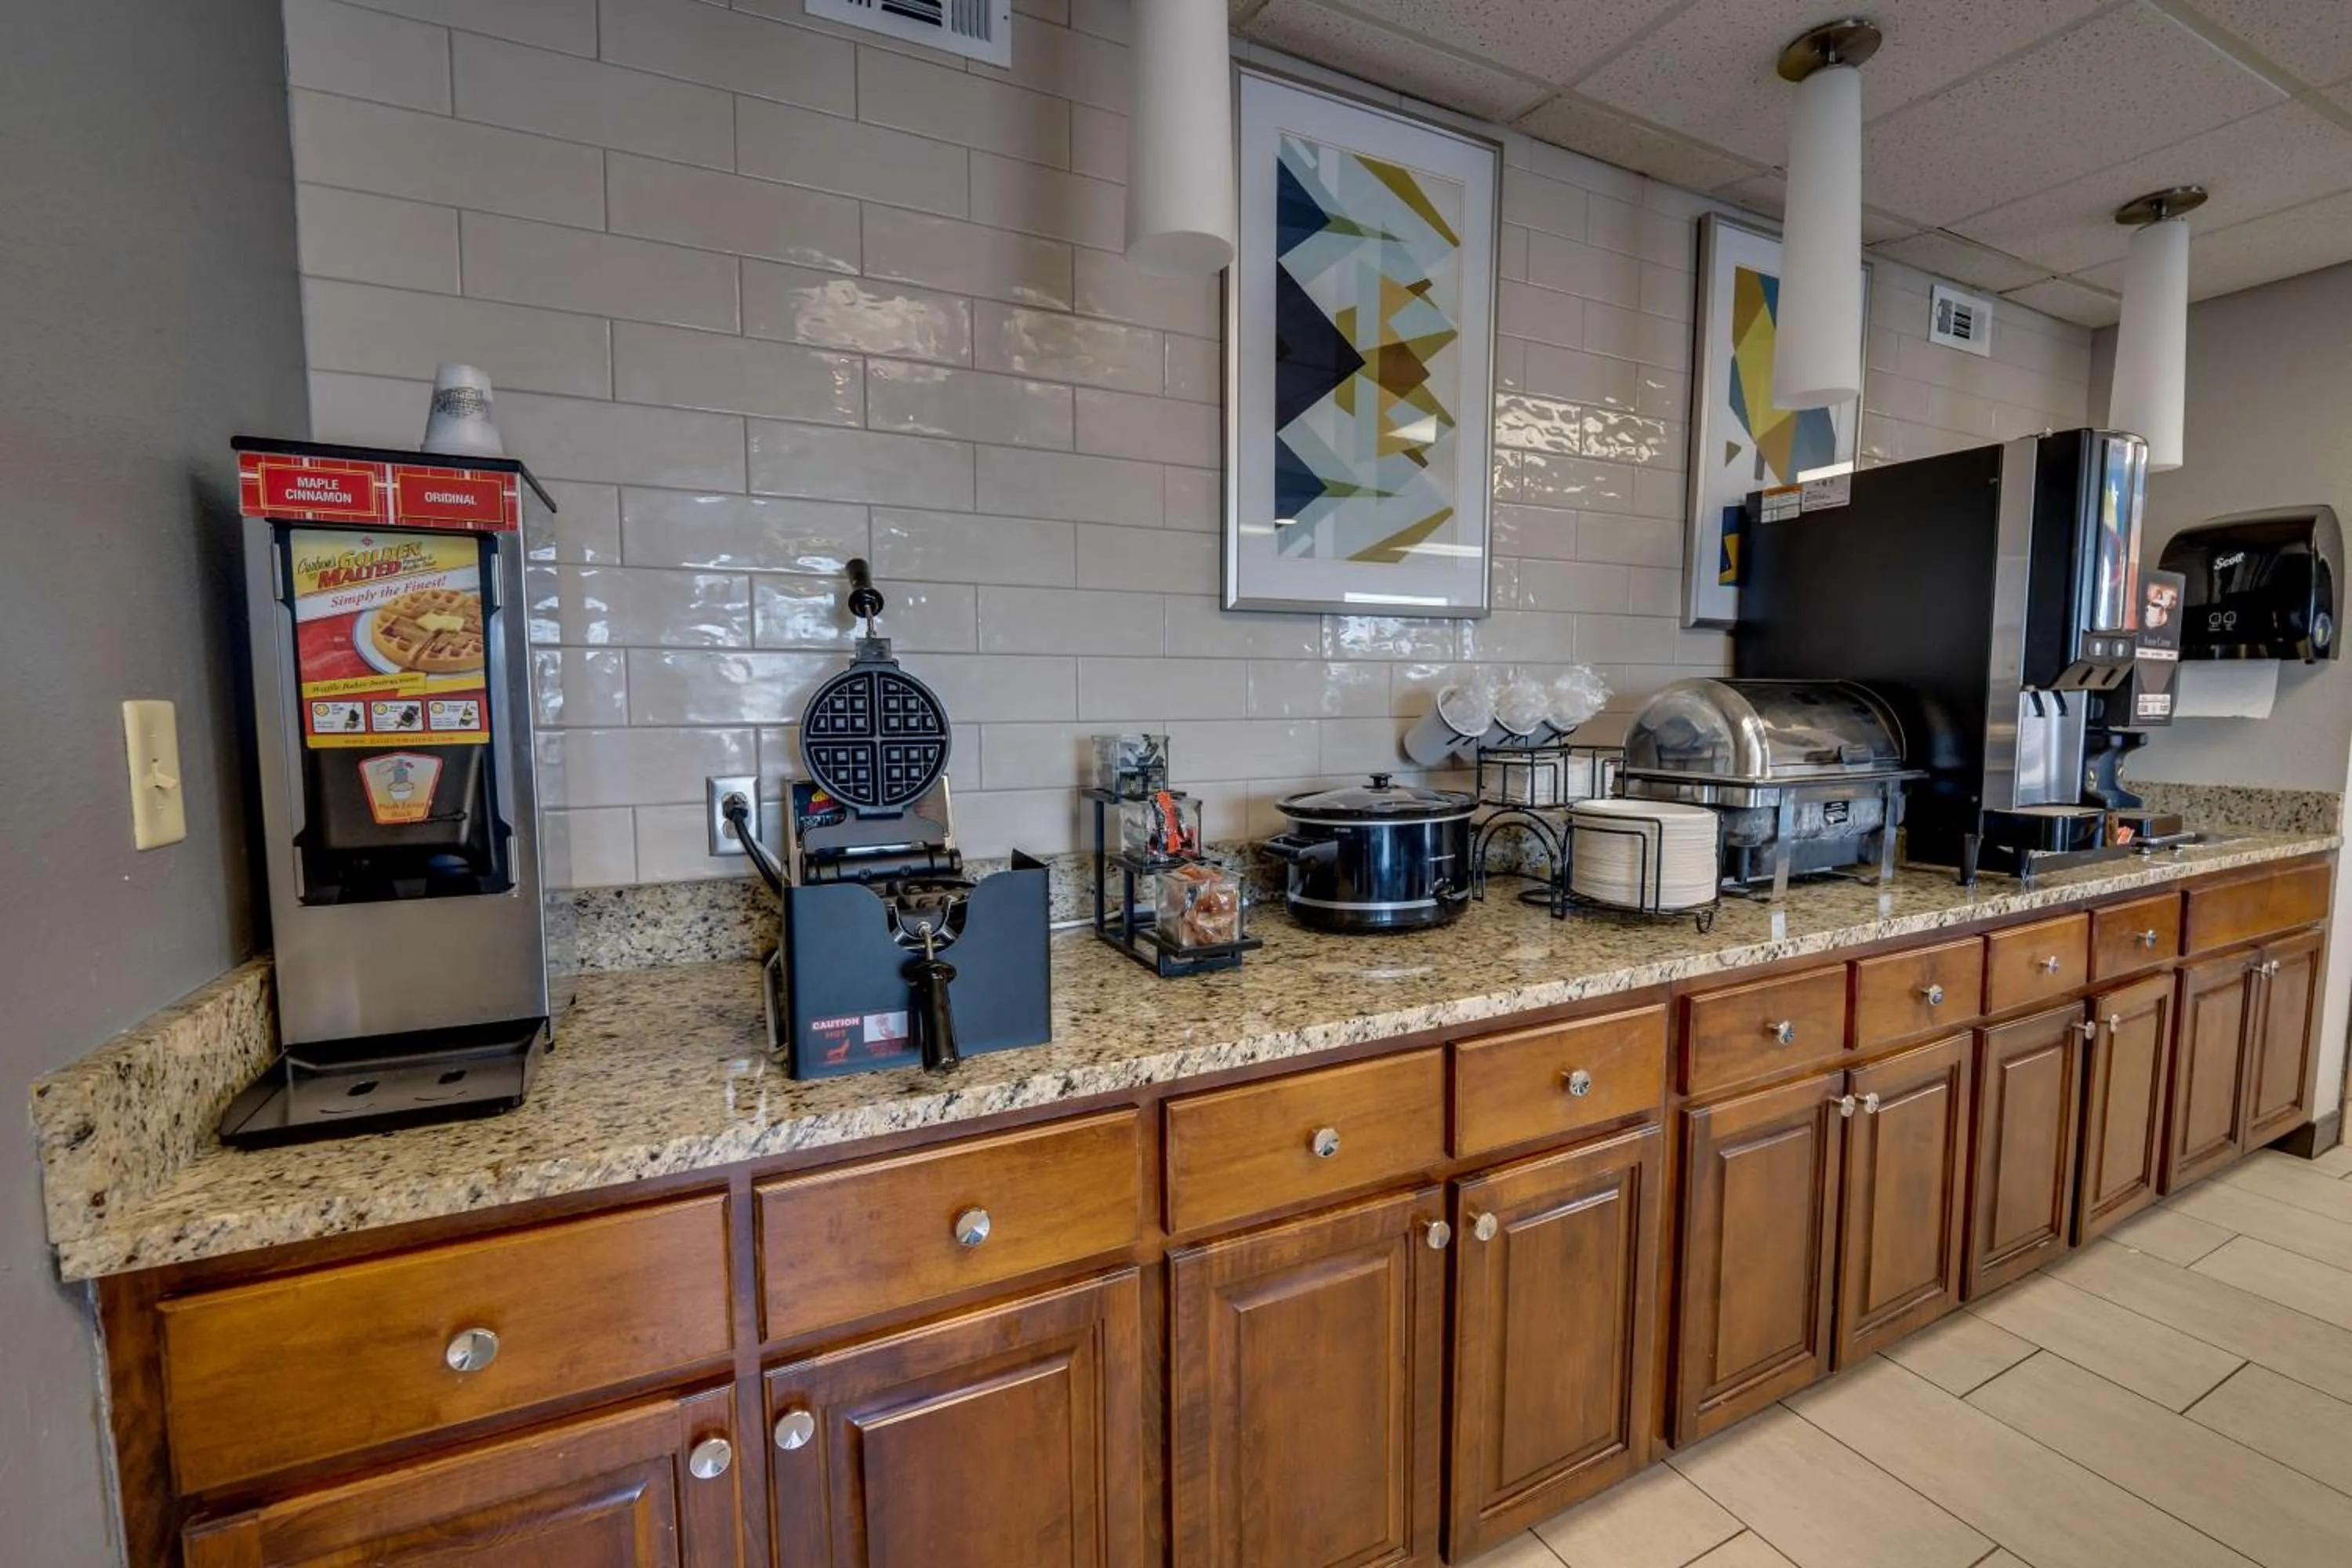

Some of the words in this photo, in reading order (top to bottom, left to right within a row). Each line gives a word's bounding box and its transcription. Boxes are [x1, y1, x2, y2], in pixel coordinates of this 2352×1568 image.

[296, 476, 339, 491] MAPLE
[285, 488, 352, 504] CINNAMON
[424, 491, 477, 506] ORIGINAL
[2212, 551, 2245, 570] Scott
[318, 560, 402, 589] MALTED
[330, 590, 378, 608] Simply
[380, 584, 397, 597] the
[404, 575, 447, 593] Finest!
[811, 1017, 860, 1030] CAUTION
